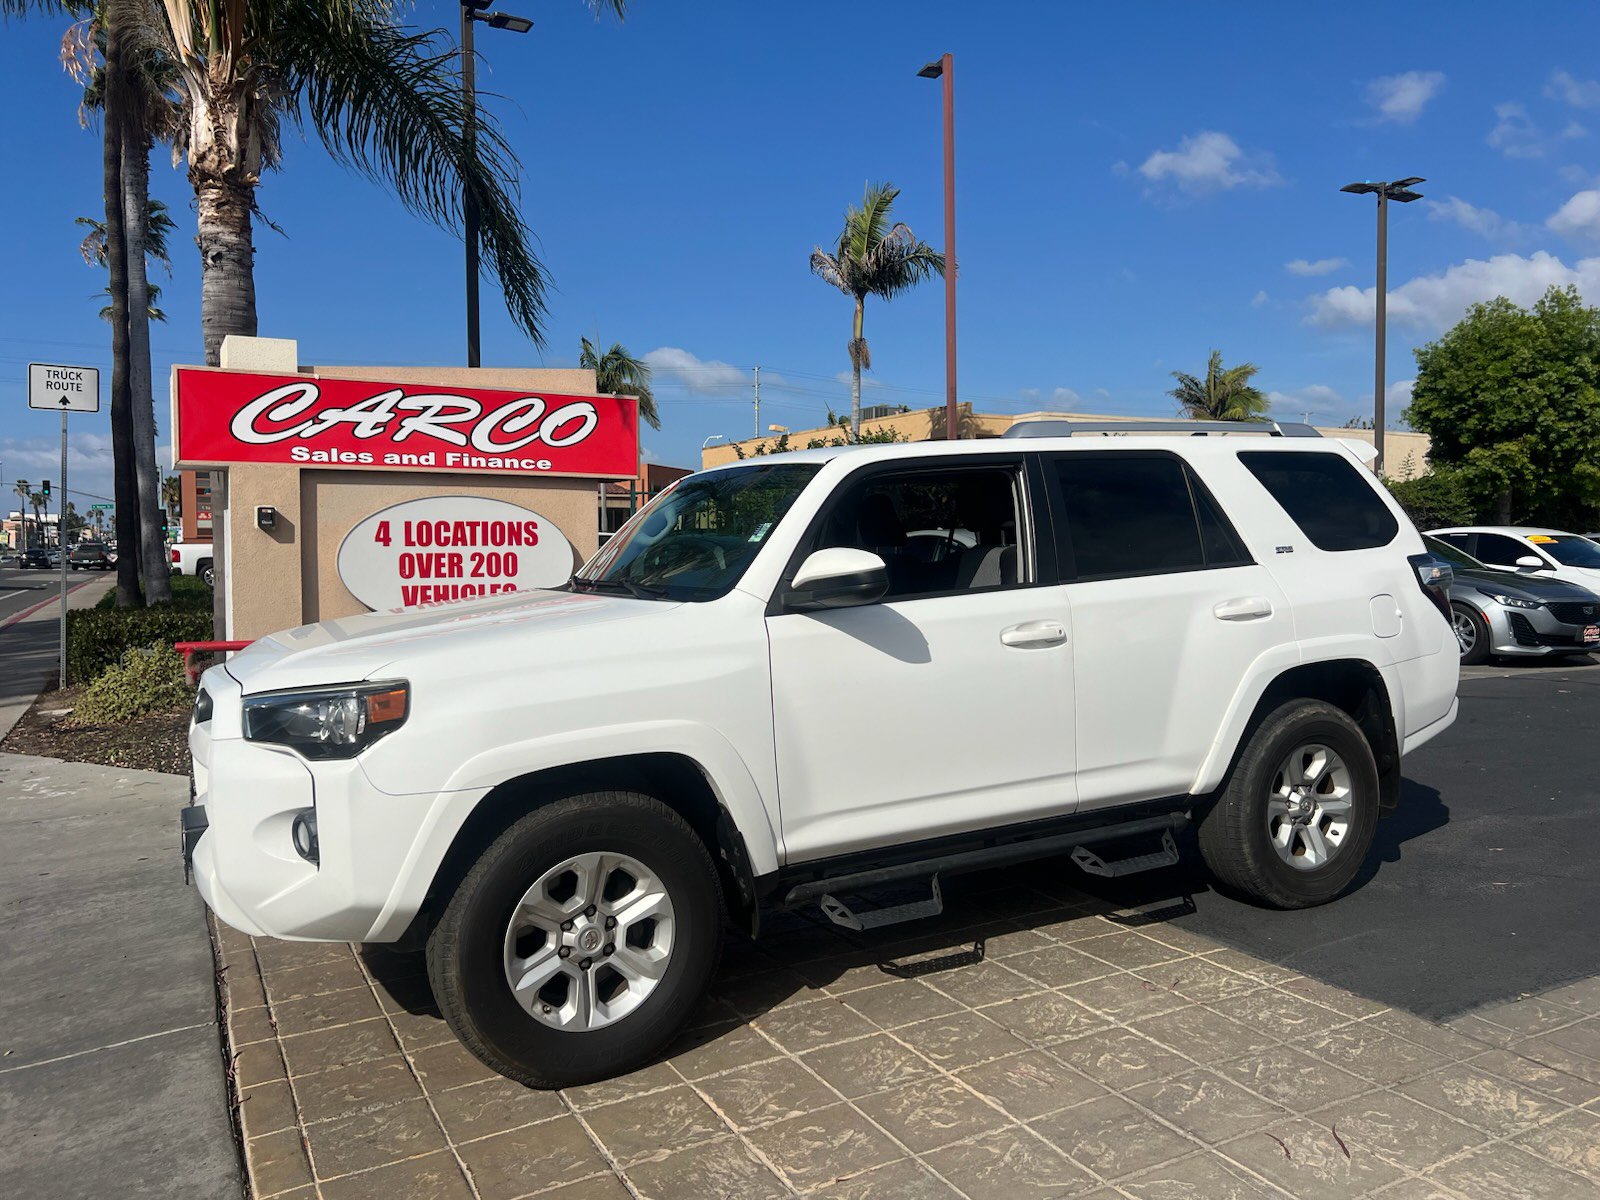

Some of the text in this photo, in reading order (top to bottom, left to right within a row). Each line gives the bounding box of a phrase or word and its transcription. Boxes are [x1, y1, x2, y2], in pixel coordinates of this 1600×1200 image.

[46, 369, 83, 381] TRUCK
[46, 380, 83, 392] ROUTE
[229, 381, 599, 454] CARCO
[290, 445, 552, 470] Sales and Finance
[374, 520, 539, 547] 4 LOCATIONS
[398, 551, 518, 579] OVER 200
